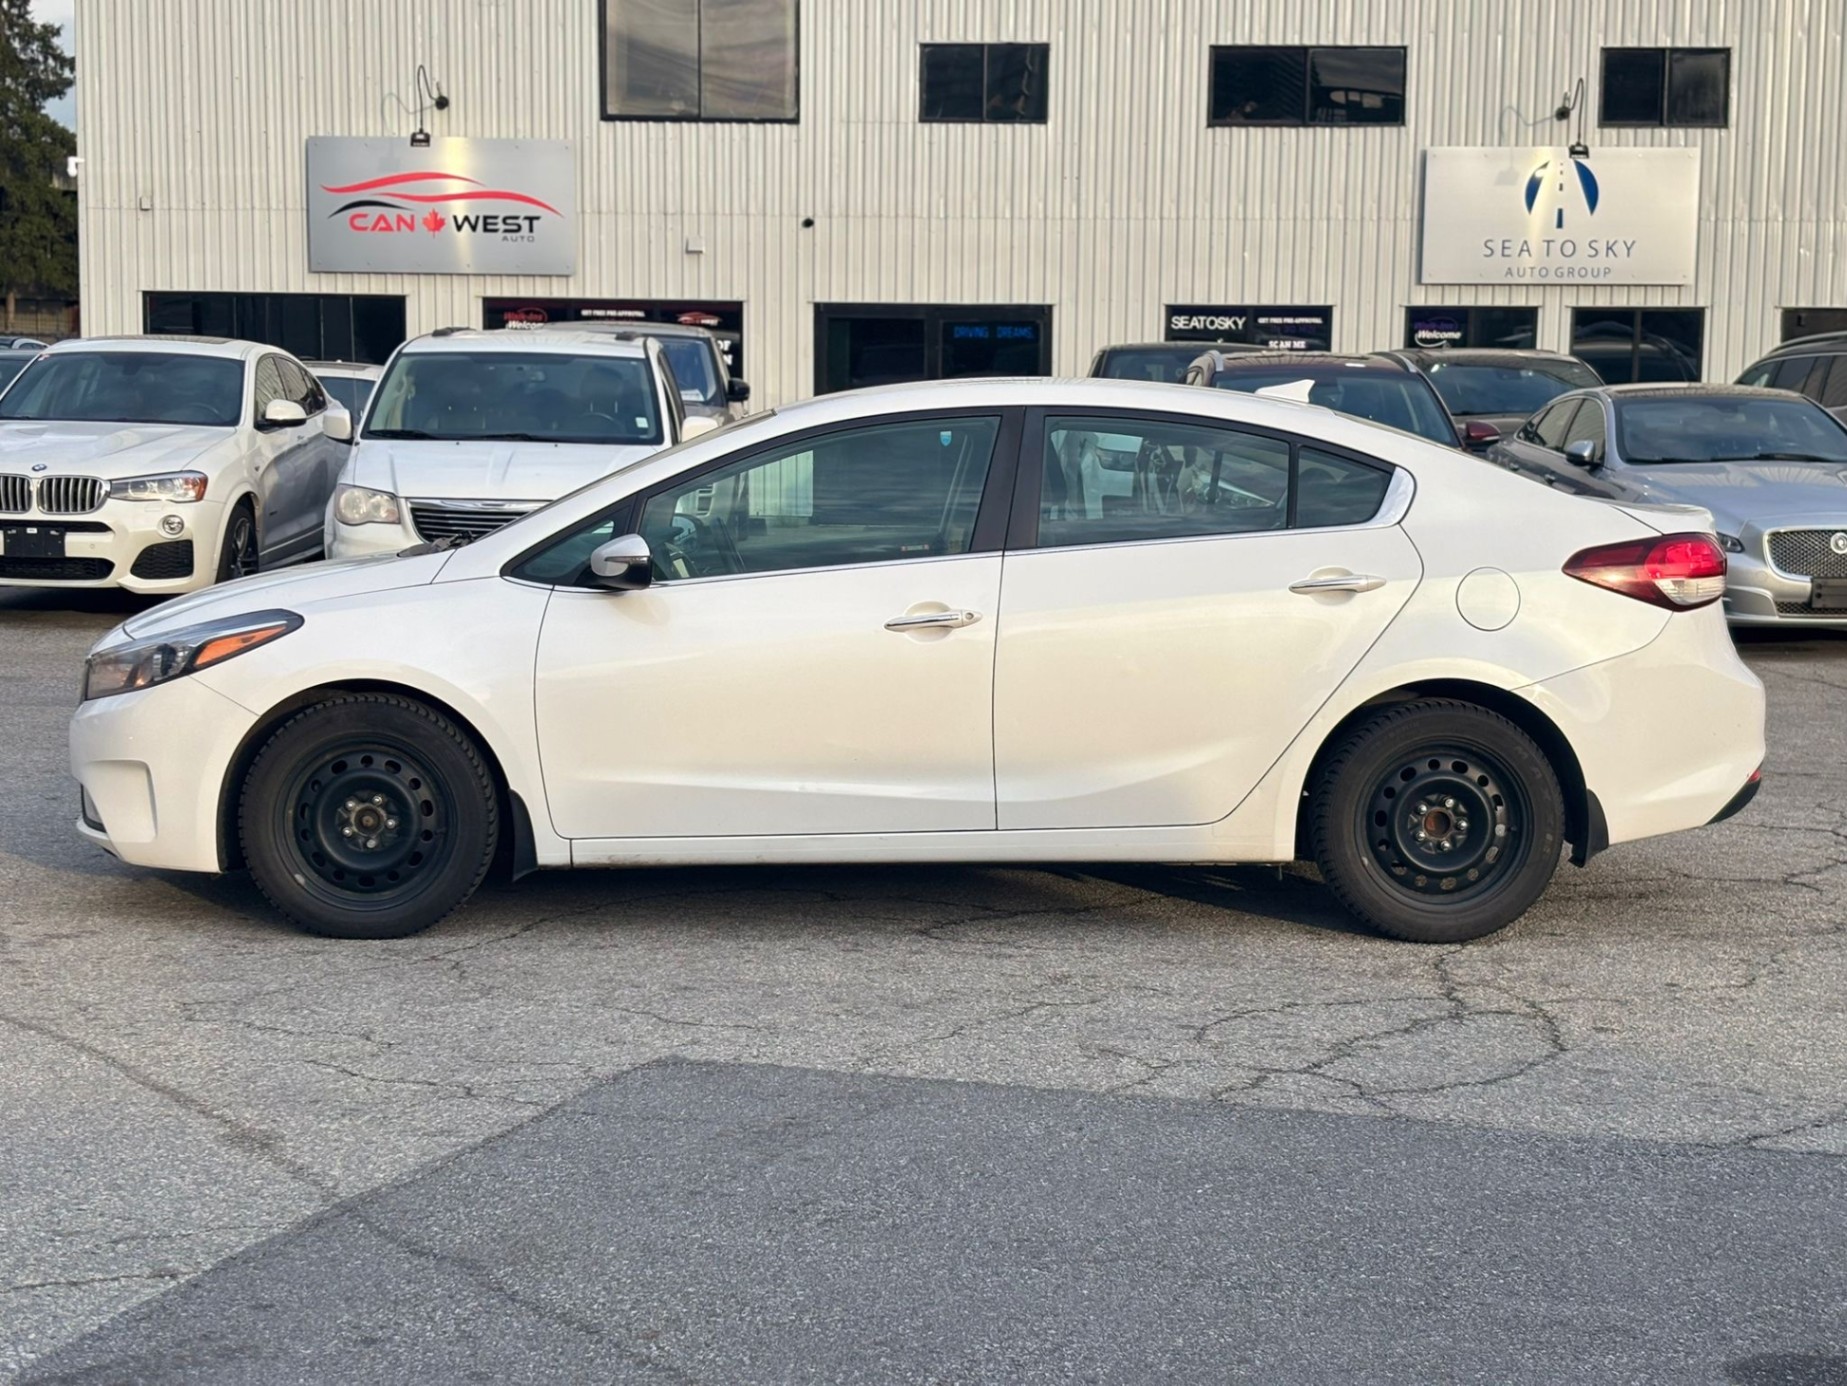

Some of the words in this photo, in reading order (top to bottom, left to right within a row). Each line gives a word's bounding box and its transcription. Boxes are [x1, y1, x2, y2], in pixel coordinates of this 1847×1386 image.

[349, 213, 415, 232] CAN
[452, 215, 541, 233] WEST
[1483, 239, 1532, 257] SEA
[1542, 239, 1577, 257] TO
[1587, 239, 1636, 257] SKY
[1504, 266, 1549, 278] AUTO
[1554, 267, 1612, 278] GROUP
[507, 320, 546, 330] Welcom
[1171, 315, 1246, 330] SEATOSKY
[954, 326, 989, 338] DRIVING
[1417, 330, 1462, 340] Welcome
[1268, 340, 1291, 349] SCAN
